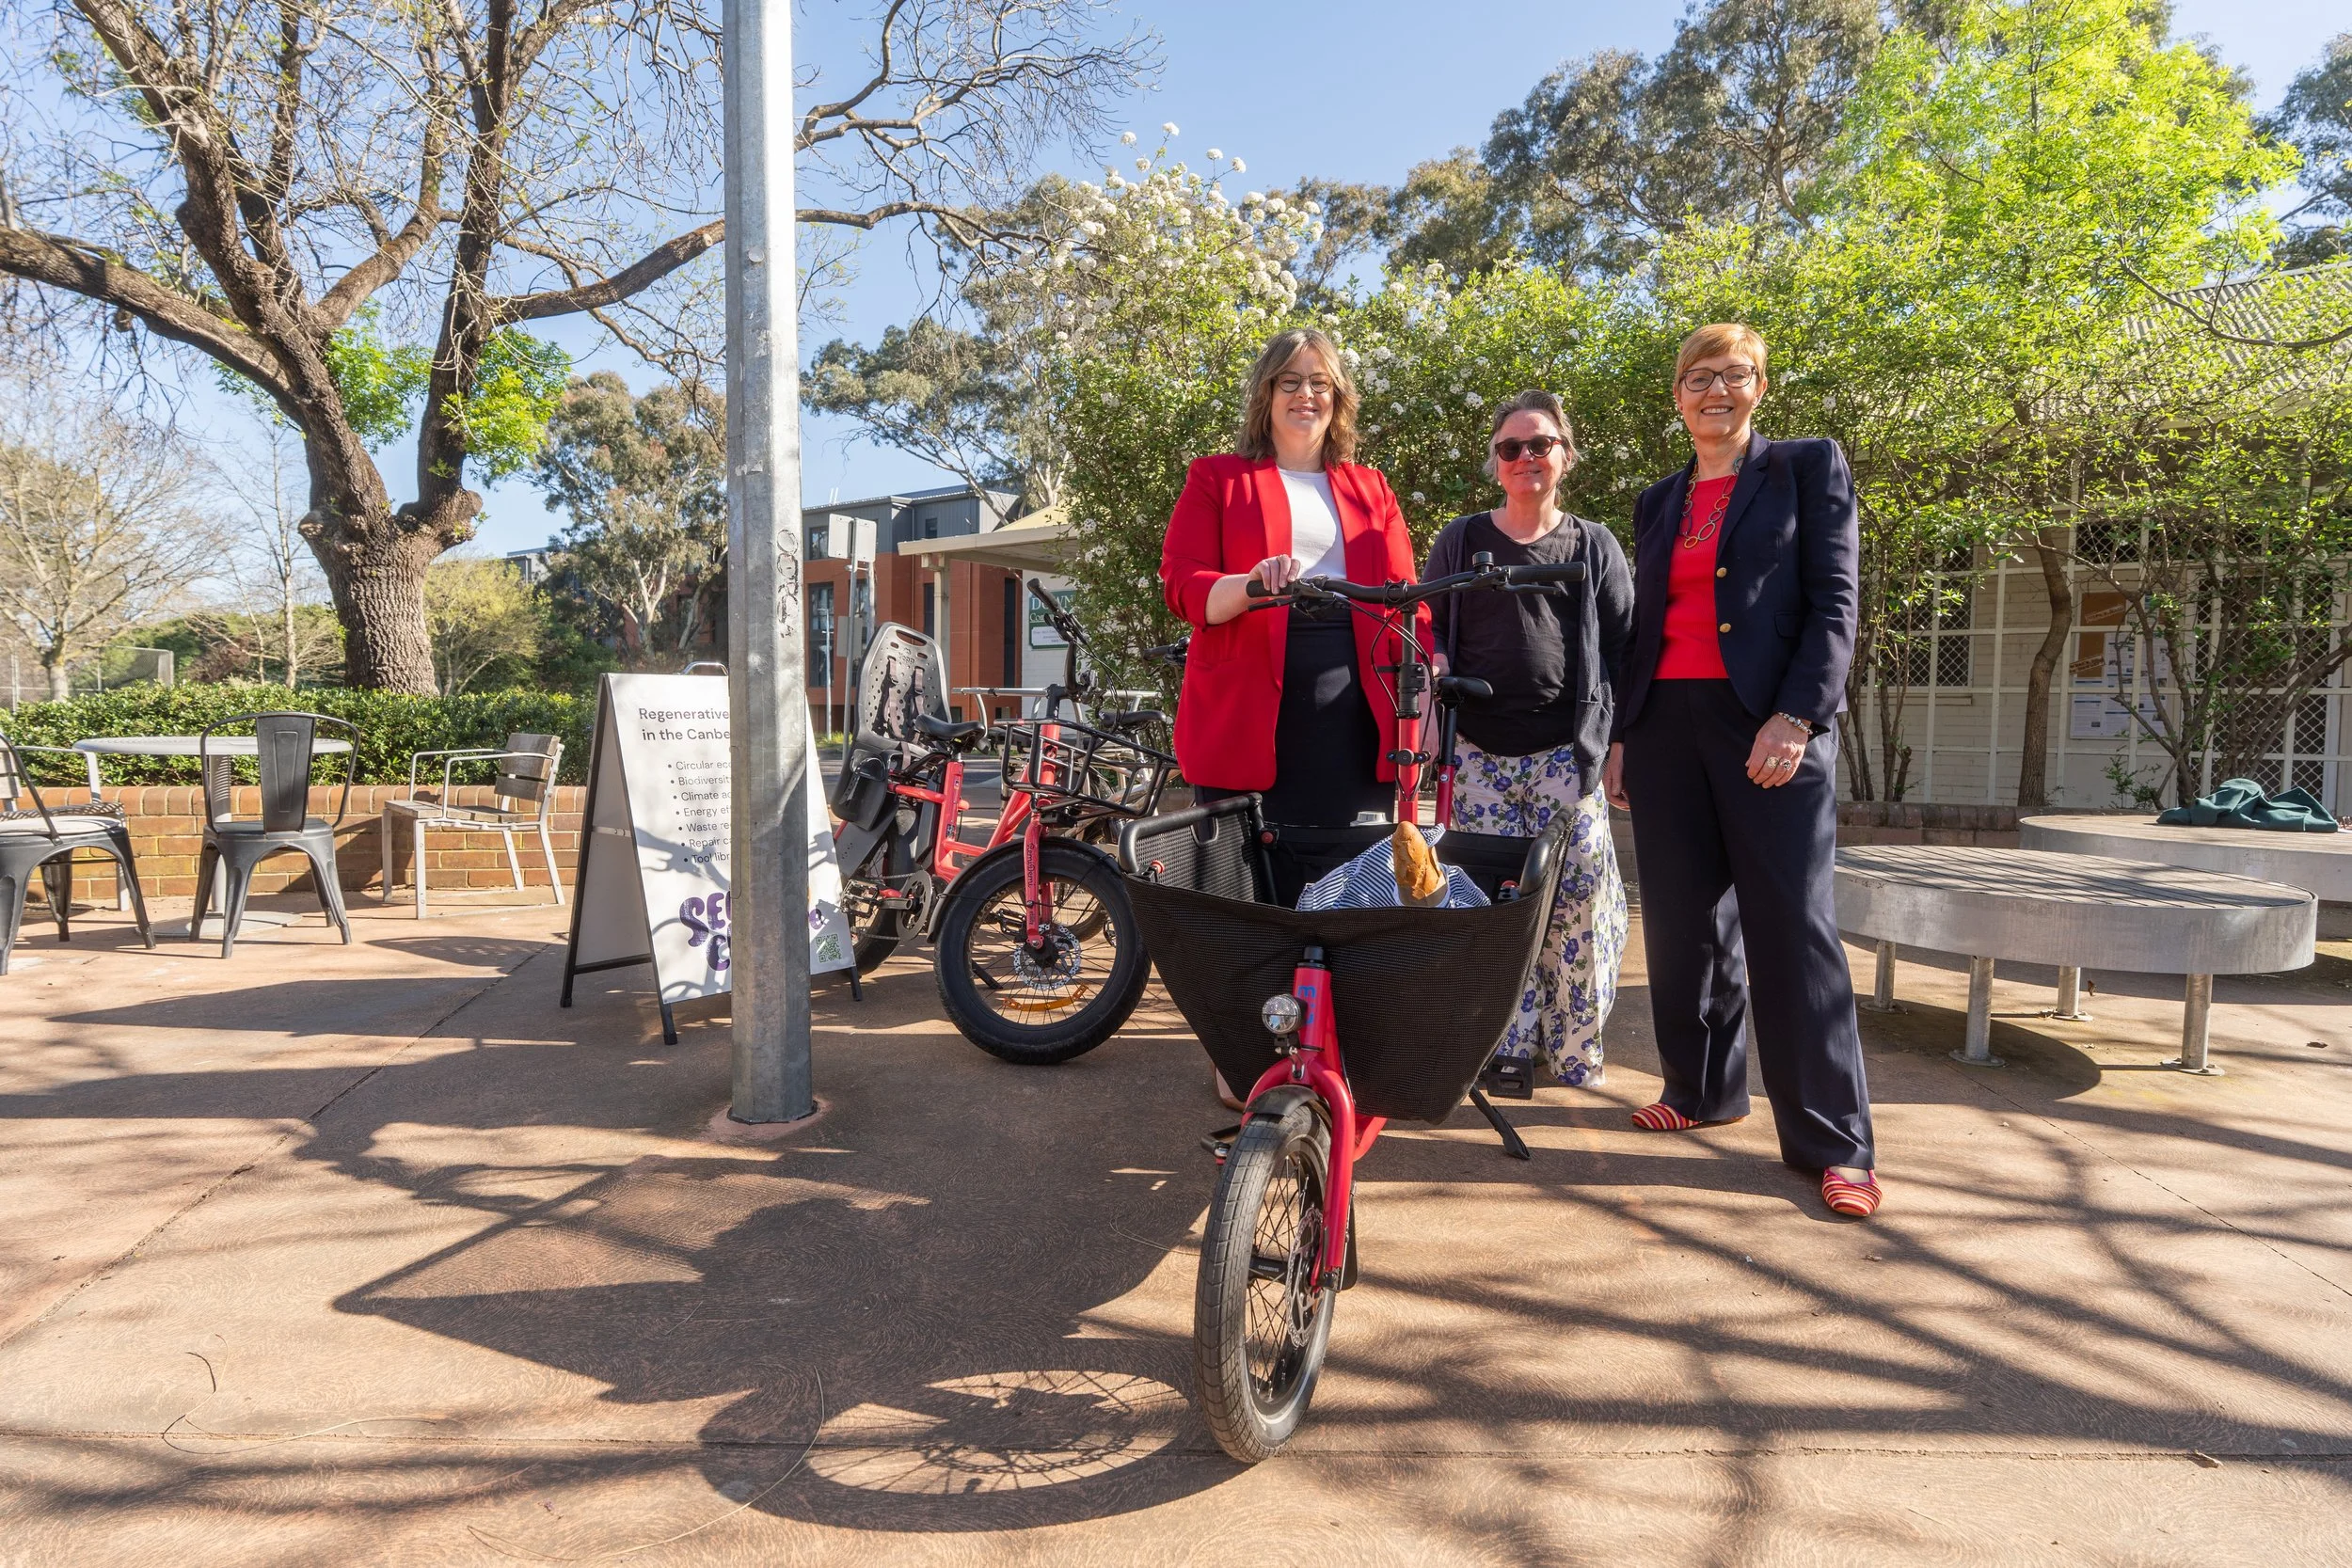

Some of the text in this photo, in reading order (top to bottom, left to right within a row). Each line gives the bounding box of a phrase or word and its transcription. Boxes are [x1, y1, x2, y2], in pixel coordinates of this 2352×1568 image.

[638, 707, 730, 723] Regenerative
[642, 728, 731, 740] in the Canbe
[675, 760, 714, 770] Circular
[678, 775, 731, 786] Biodiversit
[680, 791, 719, 801] Climate
[683, 807, 718, 817] Energy
[686, 821, 731, 832] Waste re
[689, 836, 720, 848] Repair
[691, 852, 731, 863] Tool libr
[679, 891, 731, 947] SE
